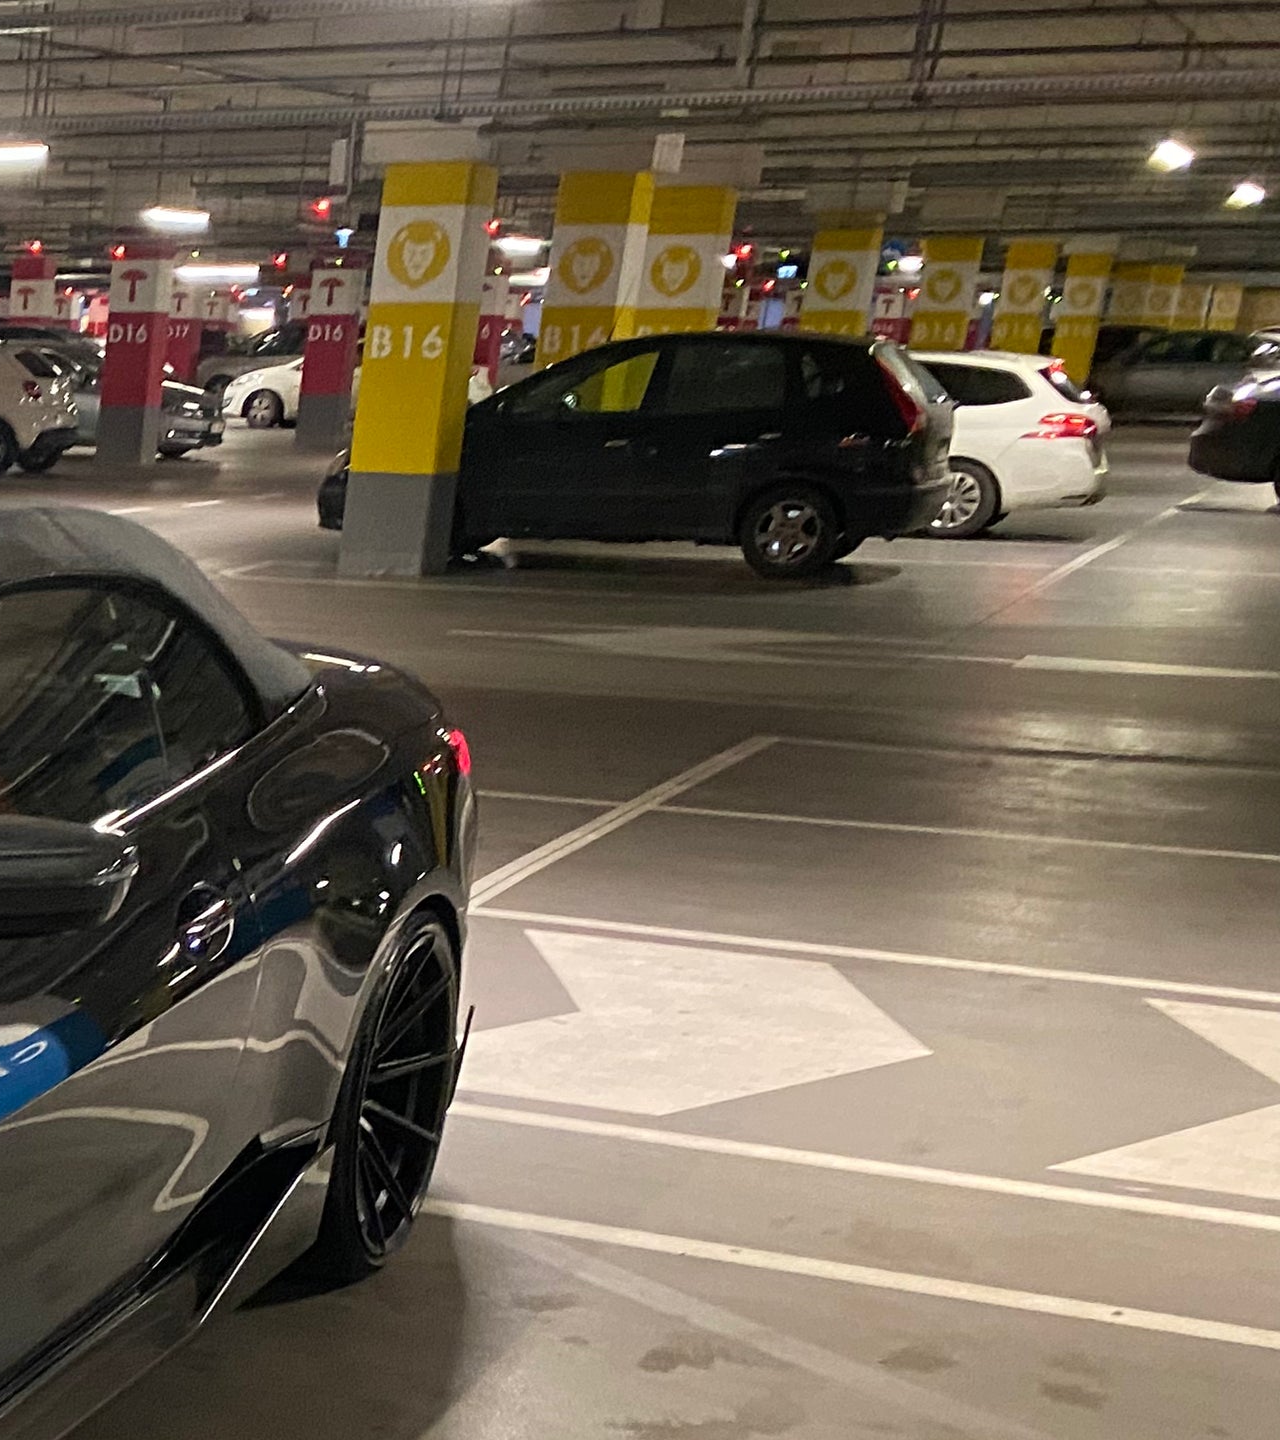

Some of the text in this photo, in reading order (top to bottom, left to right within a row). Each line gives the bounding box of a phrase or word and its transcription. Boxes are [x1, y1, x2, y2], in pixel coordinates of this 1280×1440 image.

[109, 323, 147, 343] D16
[308, 324, 343, 342] D16
[370, 324, 443, 360] B16
